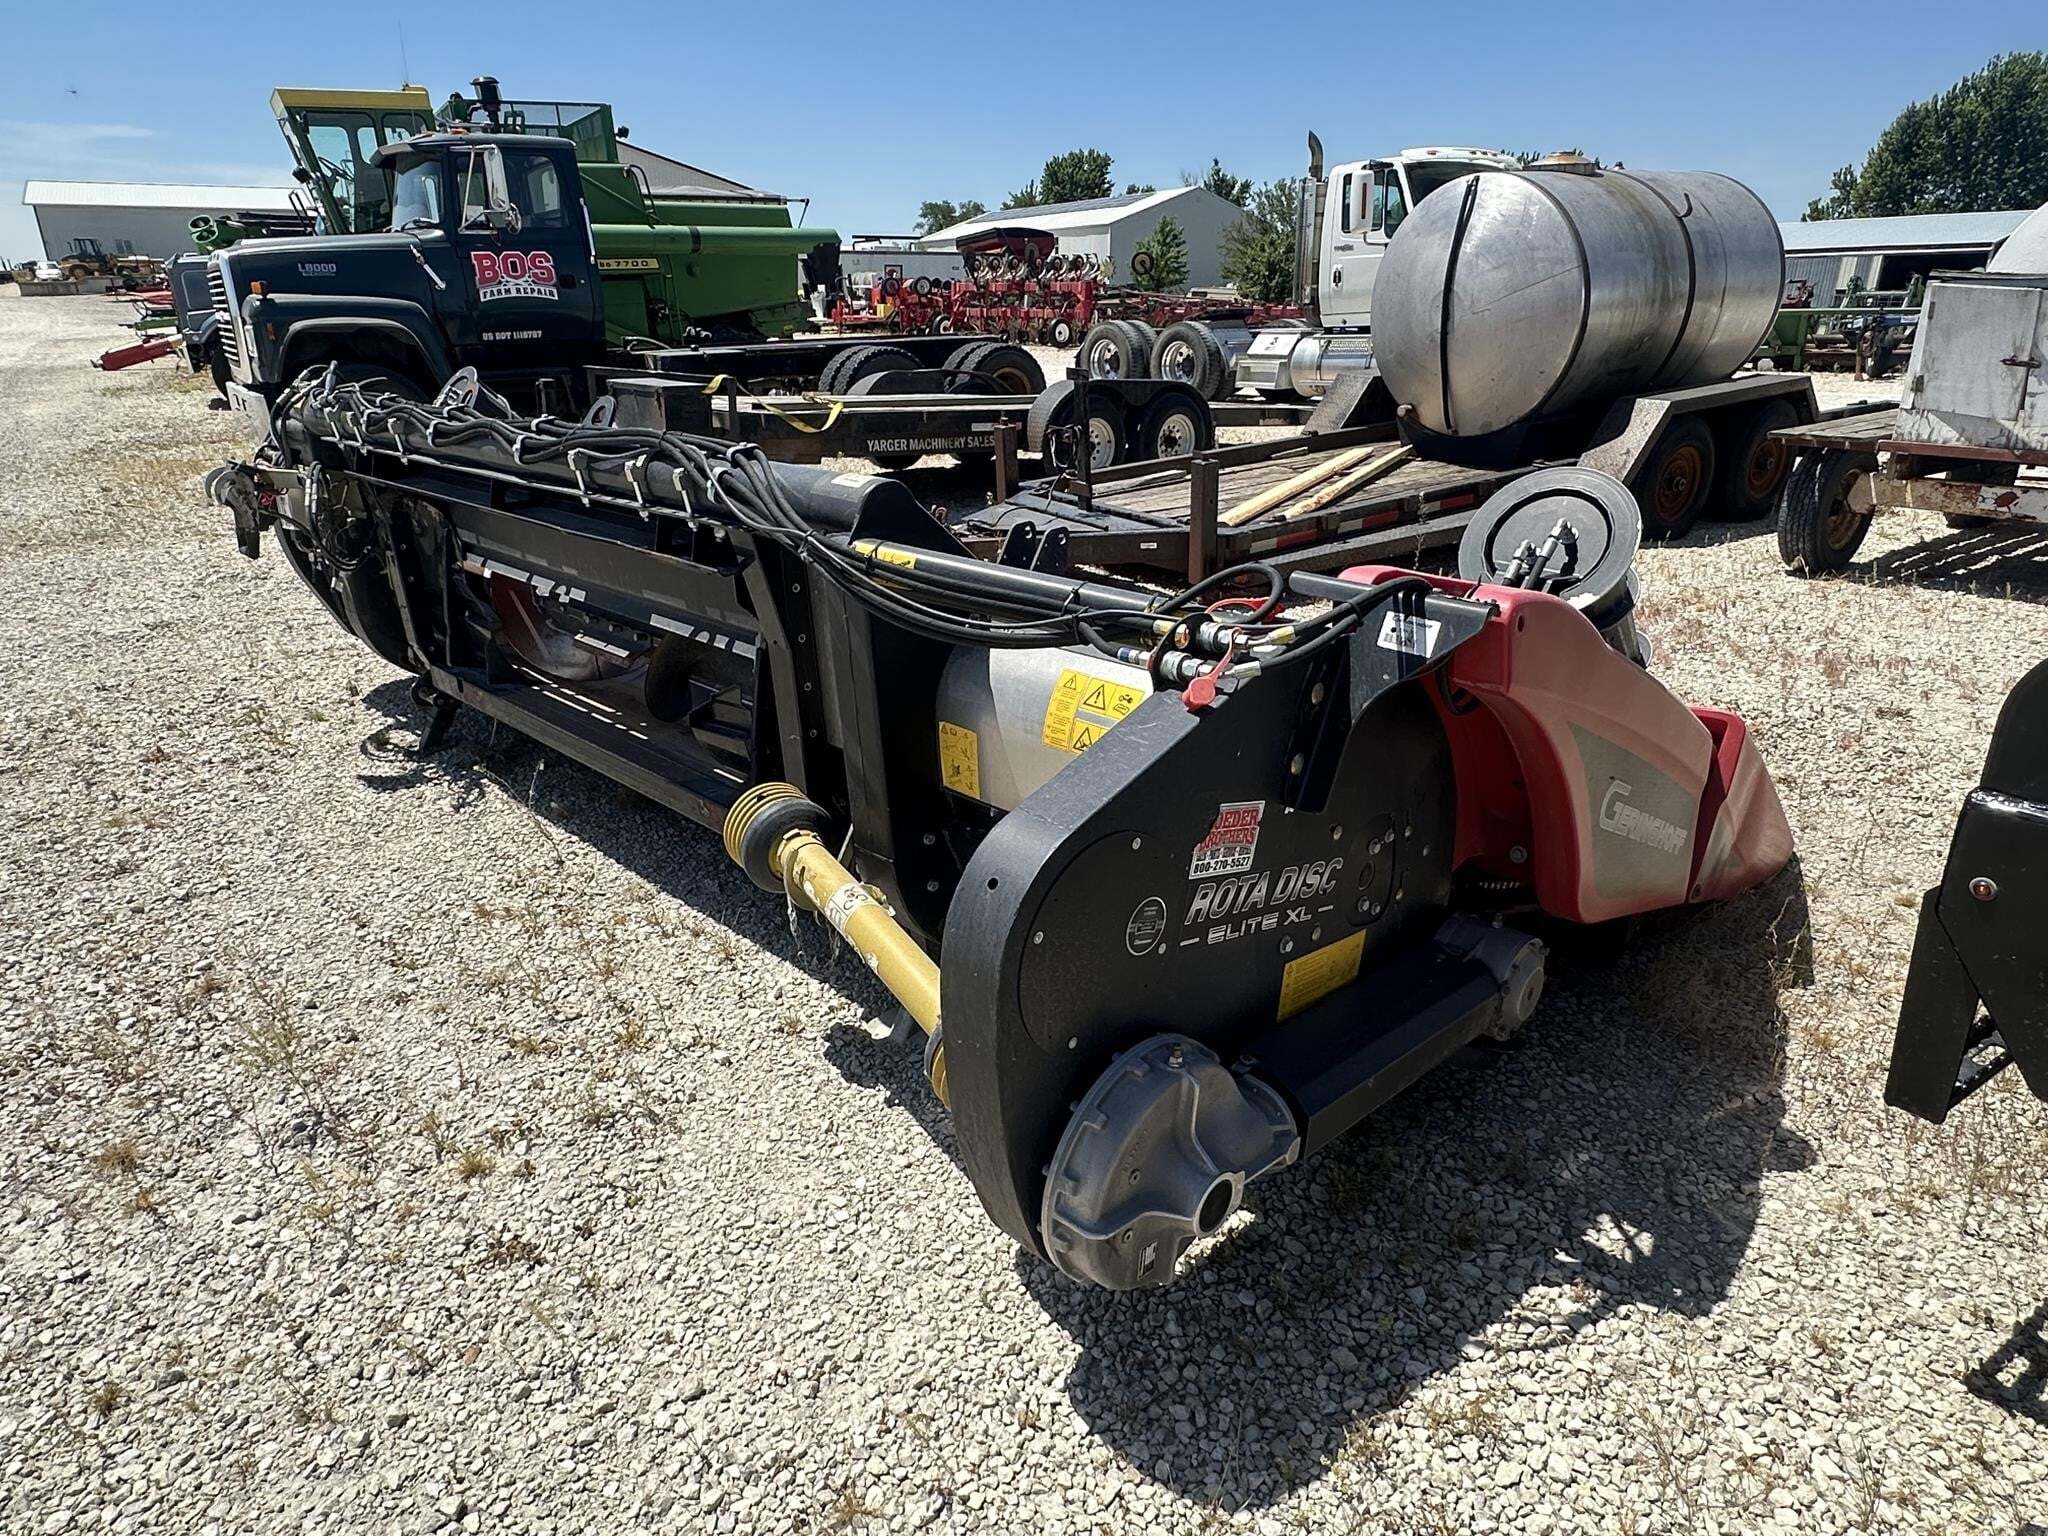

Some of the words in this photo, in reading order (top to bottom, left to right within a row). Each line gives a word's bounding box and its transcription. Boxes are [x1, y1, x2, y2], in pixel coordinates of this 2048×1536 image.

[471, 251, 557, 287] BOS
[614, 260, 649, 268] 7700
[483, 288, 511, 300] FARM
[515, 287, 556, 298] REPAIR
[866, 438, 908, 453] YARGER
[909, 437, 965, 451] MACHINERY
[967, 435, 996, 448] SALES
[1193, 856, 1250, 874] 800-270-5527
[1184, 871, 1271, 925] ROTA
[1270, 858, 1344, 905] DISC
[1207, 912, 1280, 944] ELITE
[1283, 906, 1312, 926] XL
